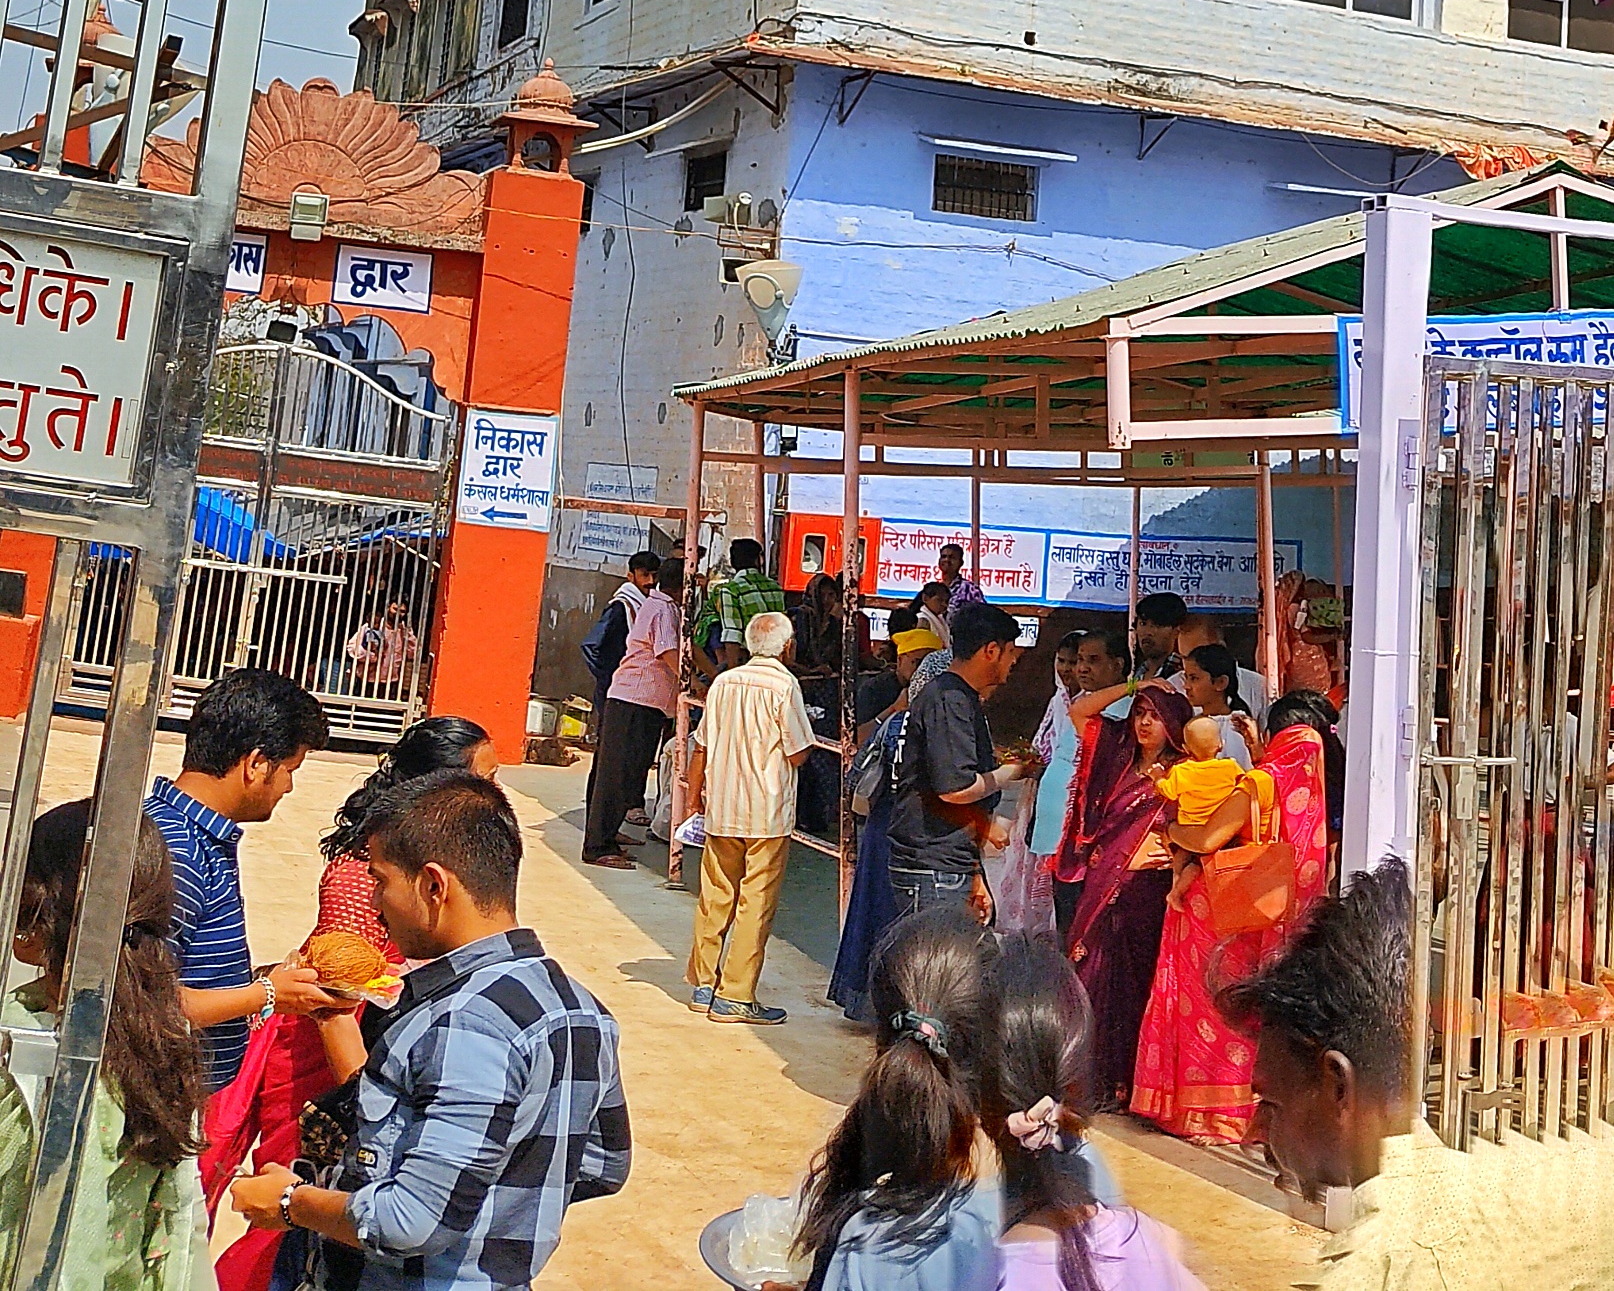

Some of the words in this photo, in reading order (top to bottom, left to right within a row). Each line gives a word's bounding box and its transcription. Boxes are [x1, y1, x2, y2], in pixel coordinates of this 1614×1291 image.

[350, 253, 414, 297] द्वार
[474, 417, 549, 458] निकास
[482, 454, 524, 480] द्वार
[464, 476, 499, 503] कंसल
[499, 482, 550, 509] धर्मशाला
[1051, 543, 1098, 566] लावारिस
